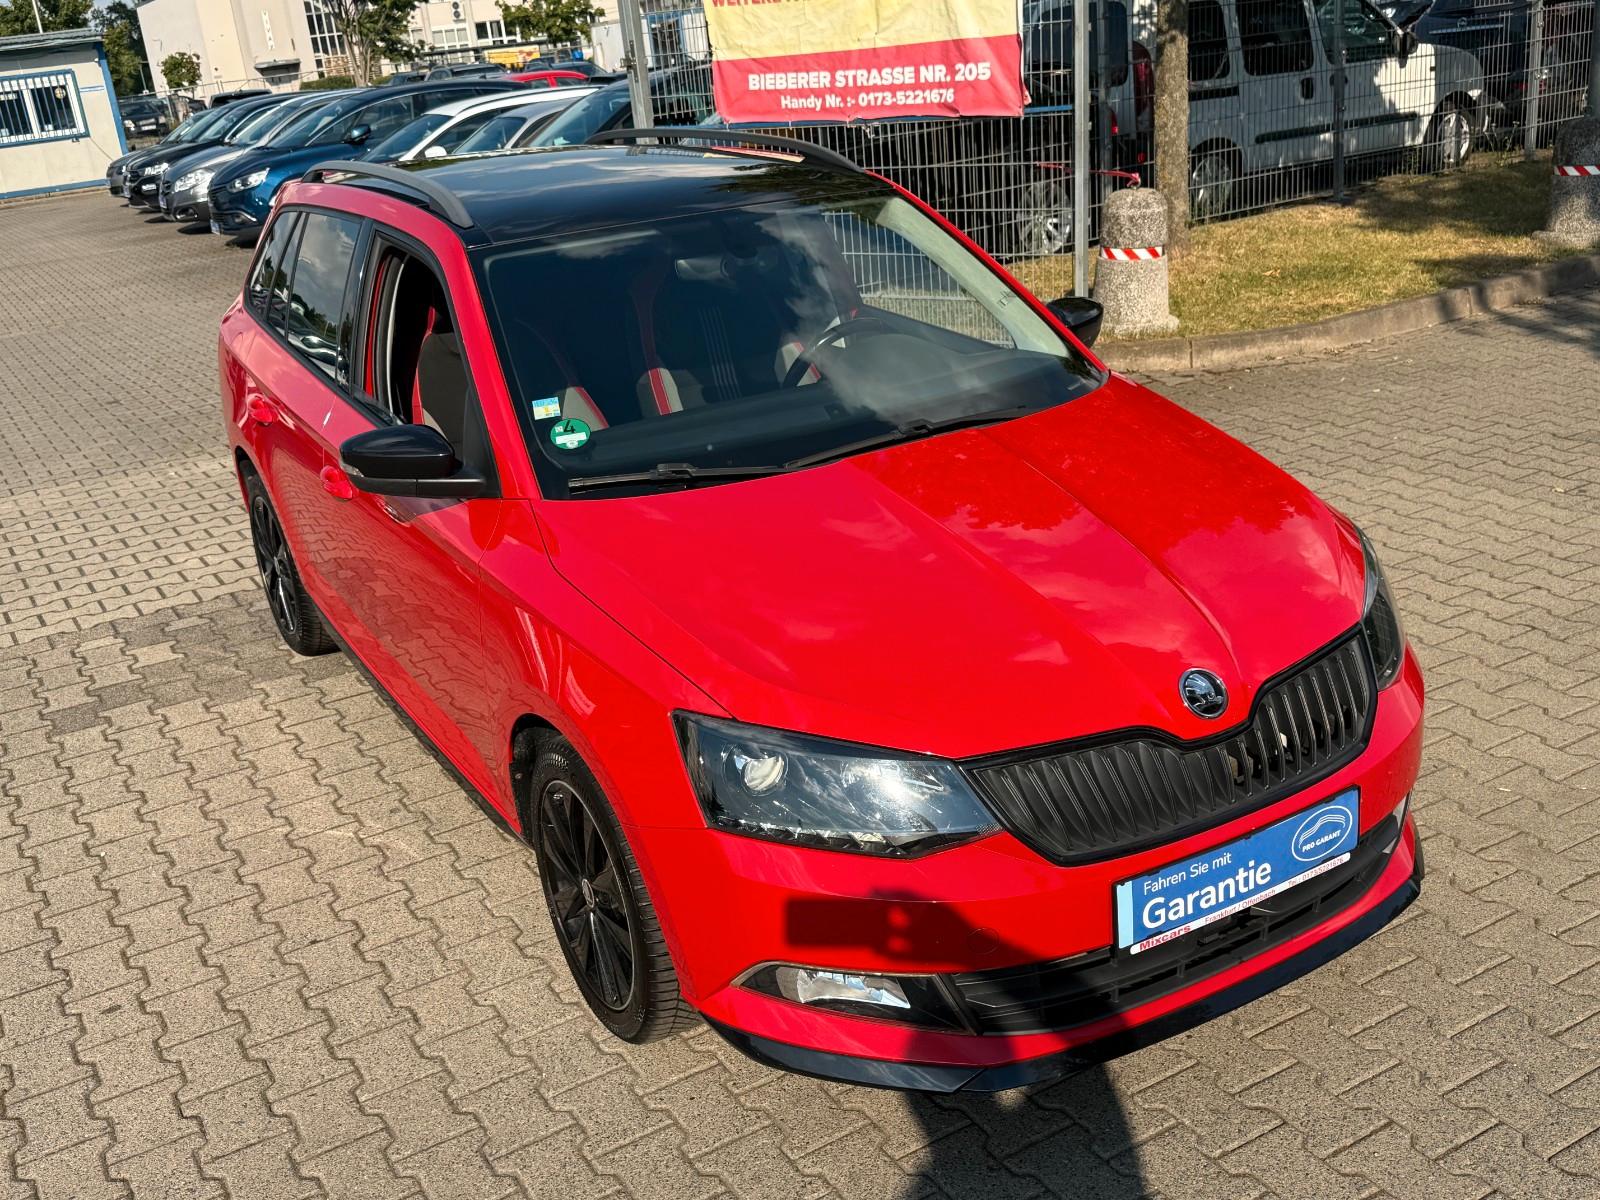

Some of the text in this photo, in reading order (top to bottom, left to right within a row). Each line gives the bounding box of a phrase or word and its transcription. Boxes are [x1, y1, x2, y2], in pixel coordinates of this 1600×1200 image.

[748, 61, 992, 90] BIEBERER STRASSE NR. 205
[780, 94, 822, 111] Handy
[825, 94, 844, 107] Nr.
[858, 88, 955, 107] 0173-5221676
[563, 420, 576, 433] 4
[1302, 829, 1342, 853] PRO GARANT
[1143, 852, 1232, 896] Fahren Sie mit
[1142, 859, 1272, 929] Garantie
[1139, 925, 1191, 951] Mixcars
